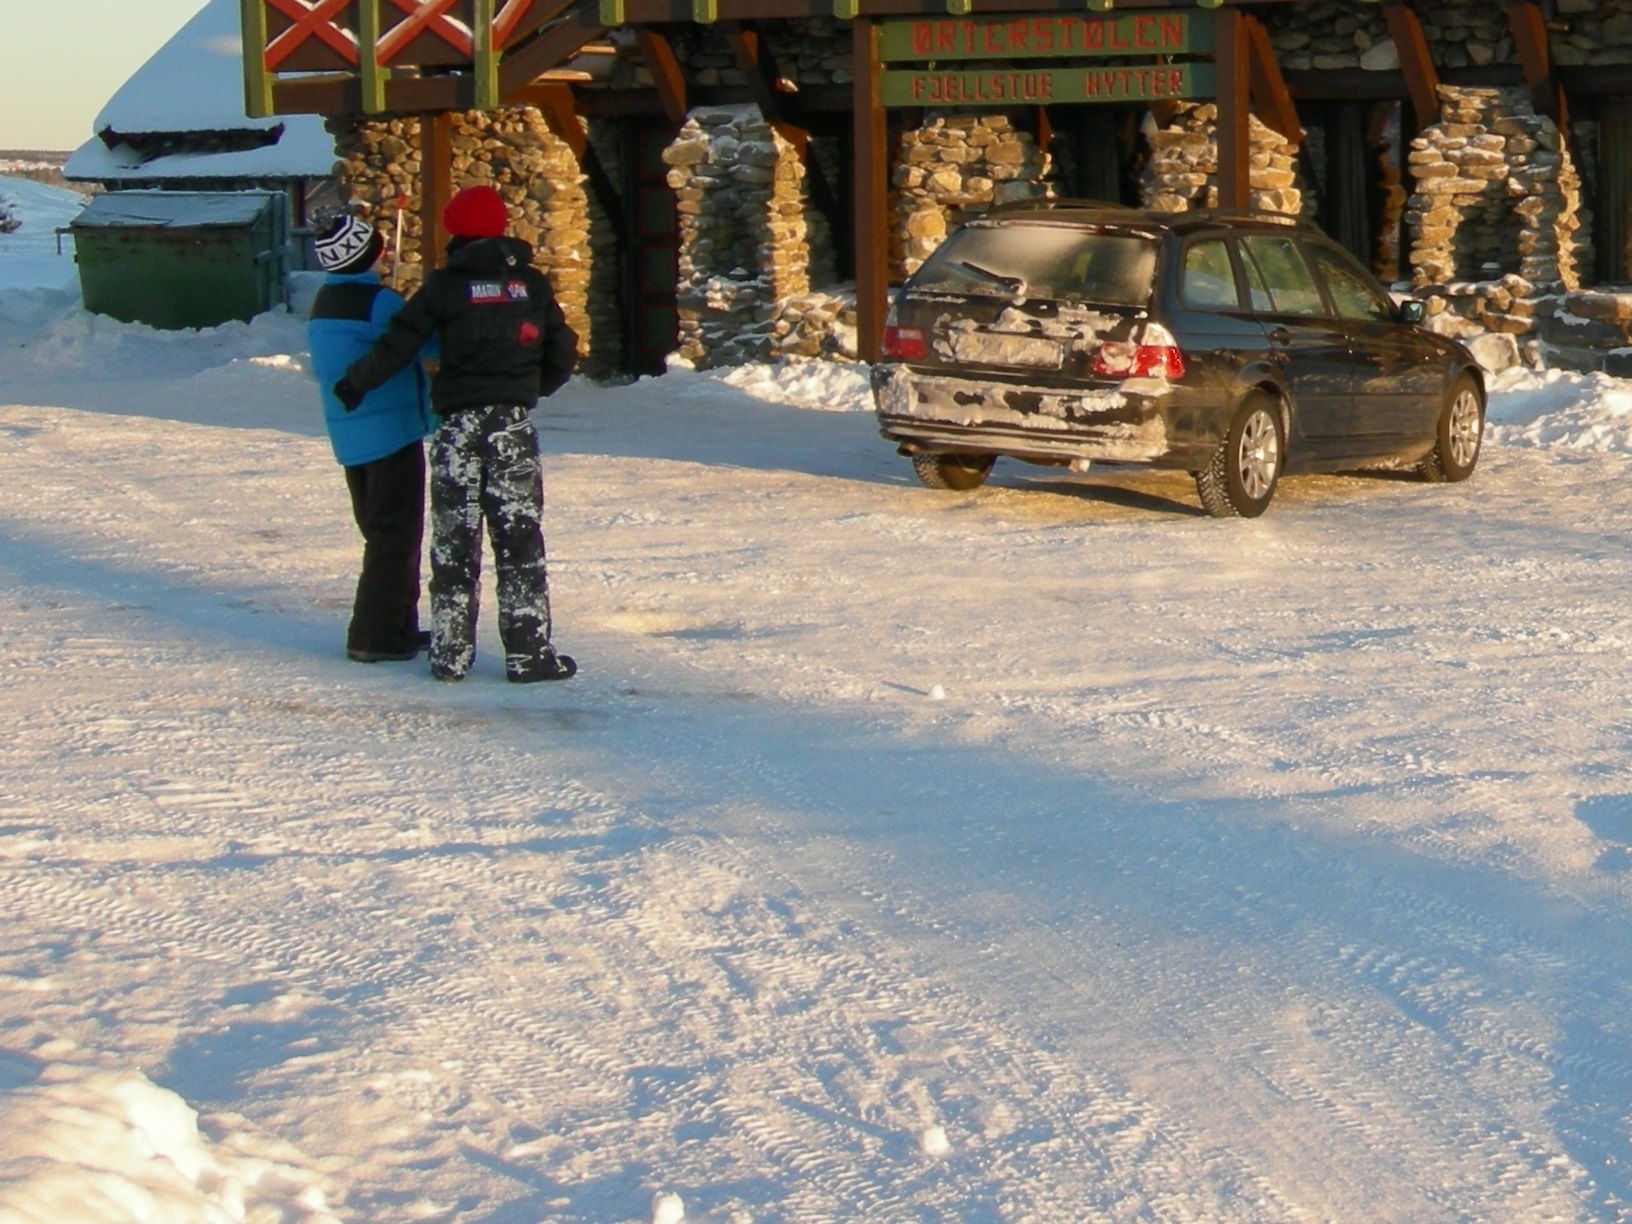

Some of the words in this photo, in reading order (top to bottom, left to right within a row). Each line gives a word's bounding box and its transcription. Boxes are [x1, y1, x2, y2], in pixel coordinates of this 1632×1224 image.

[912, 14, 1184, 56] ØRTERSTØLEN
[912, 72, 1053, 102] FJELLSTUE
[1085, 68, 1184, 98] HYTTER
